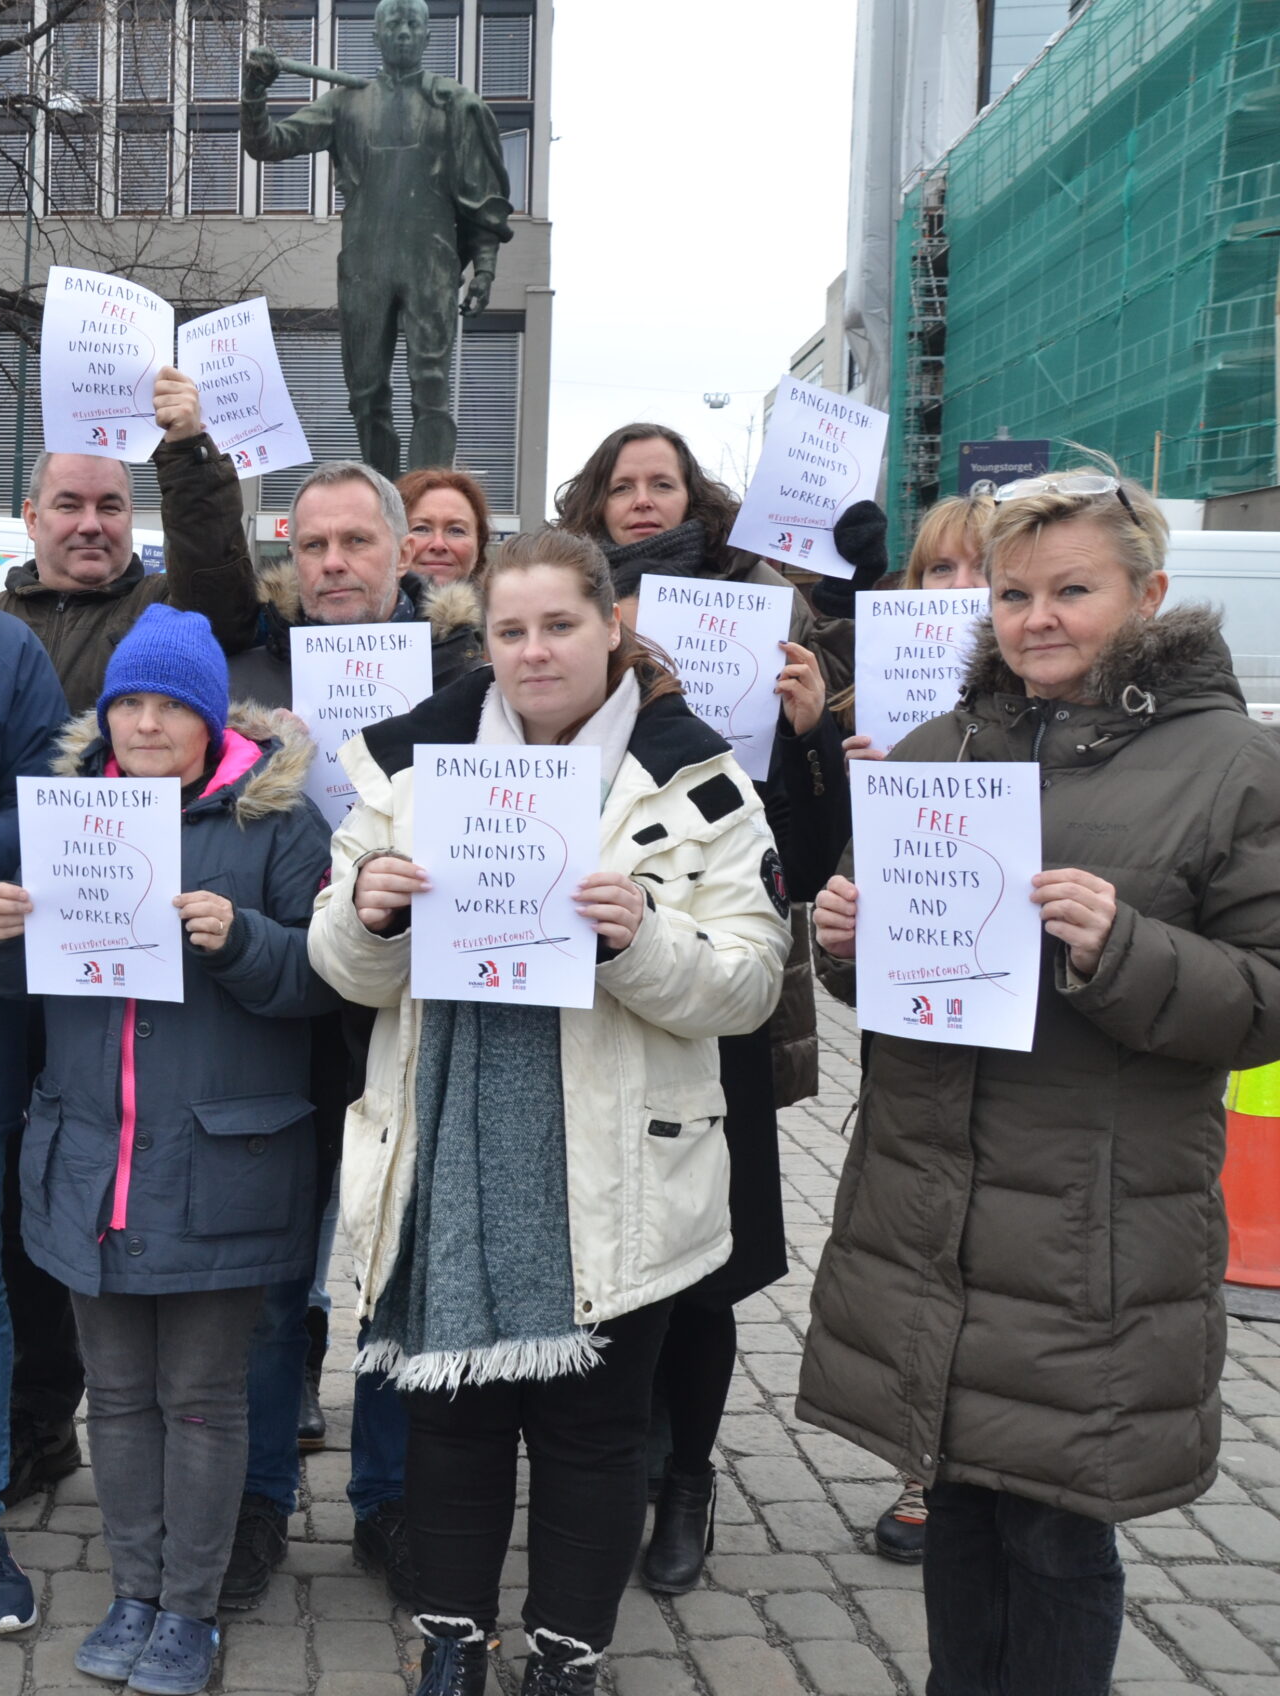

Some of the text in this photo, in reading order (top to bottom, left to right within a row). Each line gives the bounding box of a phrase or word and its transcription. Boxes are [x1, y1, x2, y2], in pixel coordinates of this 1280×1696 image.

[65, 277, 163, 314] BANGLADESH:
[101, 301, 137, 323] FREE
[80, 320, 127, 335] JAILED
[186, 311, 255, 343] BANGLADESH:
[69, 341, 139, 356] UNIONISTS
[211, 338, 238, 352] FREE
[88, 362, 115, 375] AND
[201, 356, 235, 374] JAILED
[72, 382, 133, 396] WORKERS
[196, 370, 251, 393] UNIONISTS
[216, 392, 238, 405] AND
[209, 405, 259, 426] WORKERS
[791, 388, 873, 428] BANGLADESH:
[818, 418, 848, 444] FREE
[801, 432, 839, 453] JAILED
[788, 448, 848, 475] UNIONISTS
[970, 462, 1033, 473] Youngstorget
[801, 471, 827, 486] AND
[780, 485, 836, 510] WORKERS
[658, 586, 771, 612] BANGLADESH:
[699, 613, 737, 637] FREE
[915, 623, 955, 642] FREE
[306, 634, 413, 653] BANGLADESH:
[675, 635, 727, 652] JAILED
[895, 646, 945, 661] JAILED
[346, 659, 384, 679] FREE
[885, 667, 961, 680] UNIONISTS
[328, 684, 377, 699] JAILED
[684, 680, 713, 694] AND
[906, 689, 936, 701] AND
[319, 705, 393, 719] UNIONISTS
[342, 729, 361, 741] AN
[436, 758, 575, 779] BANGLADESH:
[868, 775, 1012, 799] BANGLADESH:
[37, 789, 158, 808] BANGLADESH:
[489, 787, 537, 813] FREE
[84, 815, 125, 838] FREE
[463, 817, 526, 835] JAILED
[917, 808, 968, 836] FREE
[62, 840, 116, 856] JAILED
[450, 845, 545, 861] UNIONISTS
[893, 839, 957, 858] JAILED
[53, 864, 134, 880] UNIONISTS
[478, 872, 515, 888] AND
[883, 868, 980, 888] UNIONISTS
[78, 888, 109, 901] AND
[455, 899, 538, 915] WORKERS
[910, 899, 947, 917] AND
[60, 909, 130, 925] WORKERS
[889, 926, 974, 947] WORKERS
[513, 962, 526, 977] UNI
[947, 999, 962, 1015] UNI
